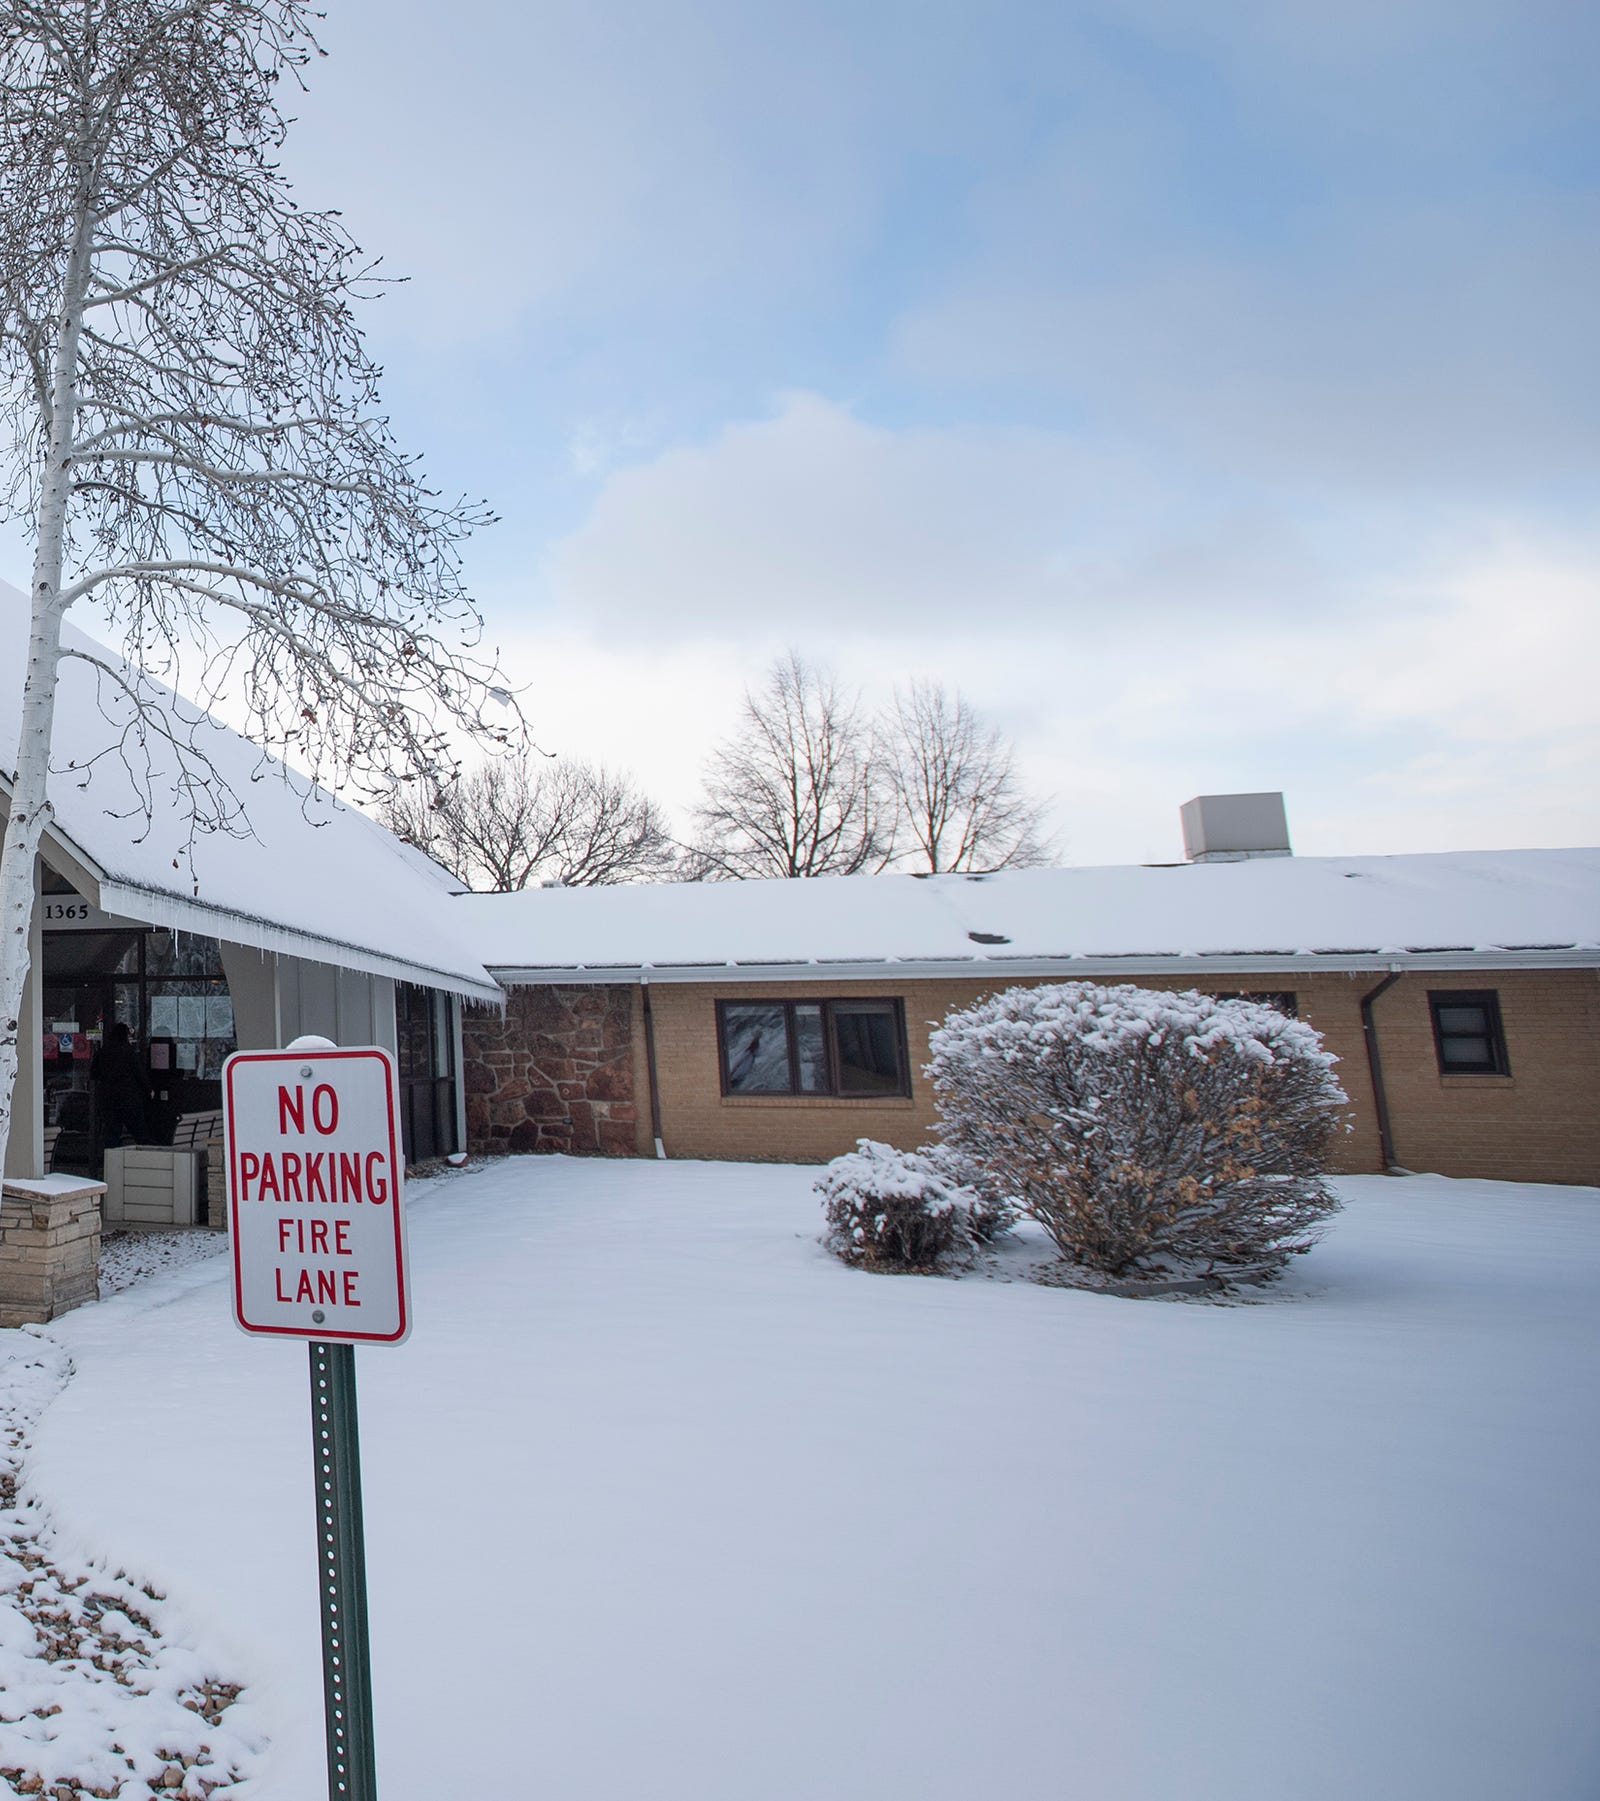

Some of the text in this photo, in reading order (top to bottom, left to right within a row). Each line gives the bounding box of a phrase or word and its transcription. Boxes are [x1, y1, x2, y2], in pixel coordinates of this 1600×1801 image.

[45, 904, 88, 919] 1365
[278, 1083, 339, 1135] NO
[240, 1151, 387, 1205] PARKING
[278, 1218, 352, 1255] FIRE
[275, 1268, 361, 1306] LANE
